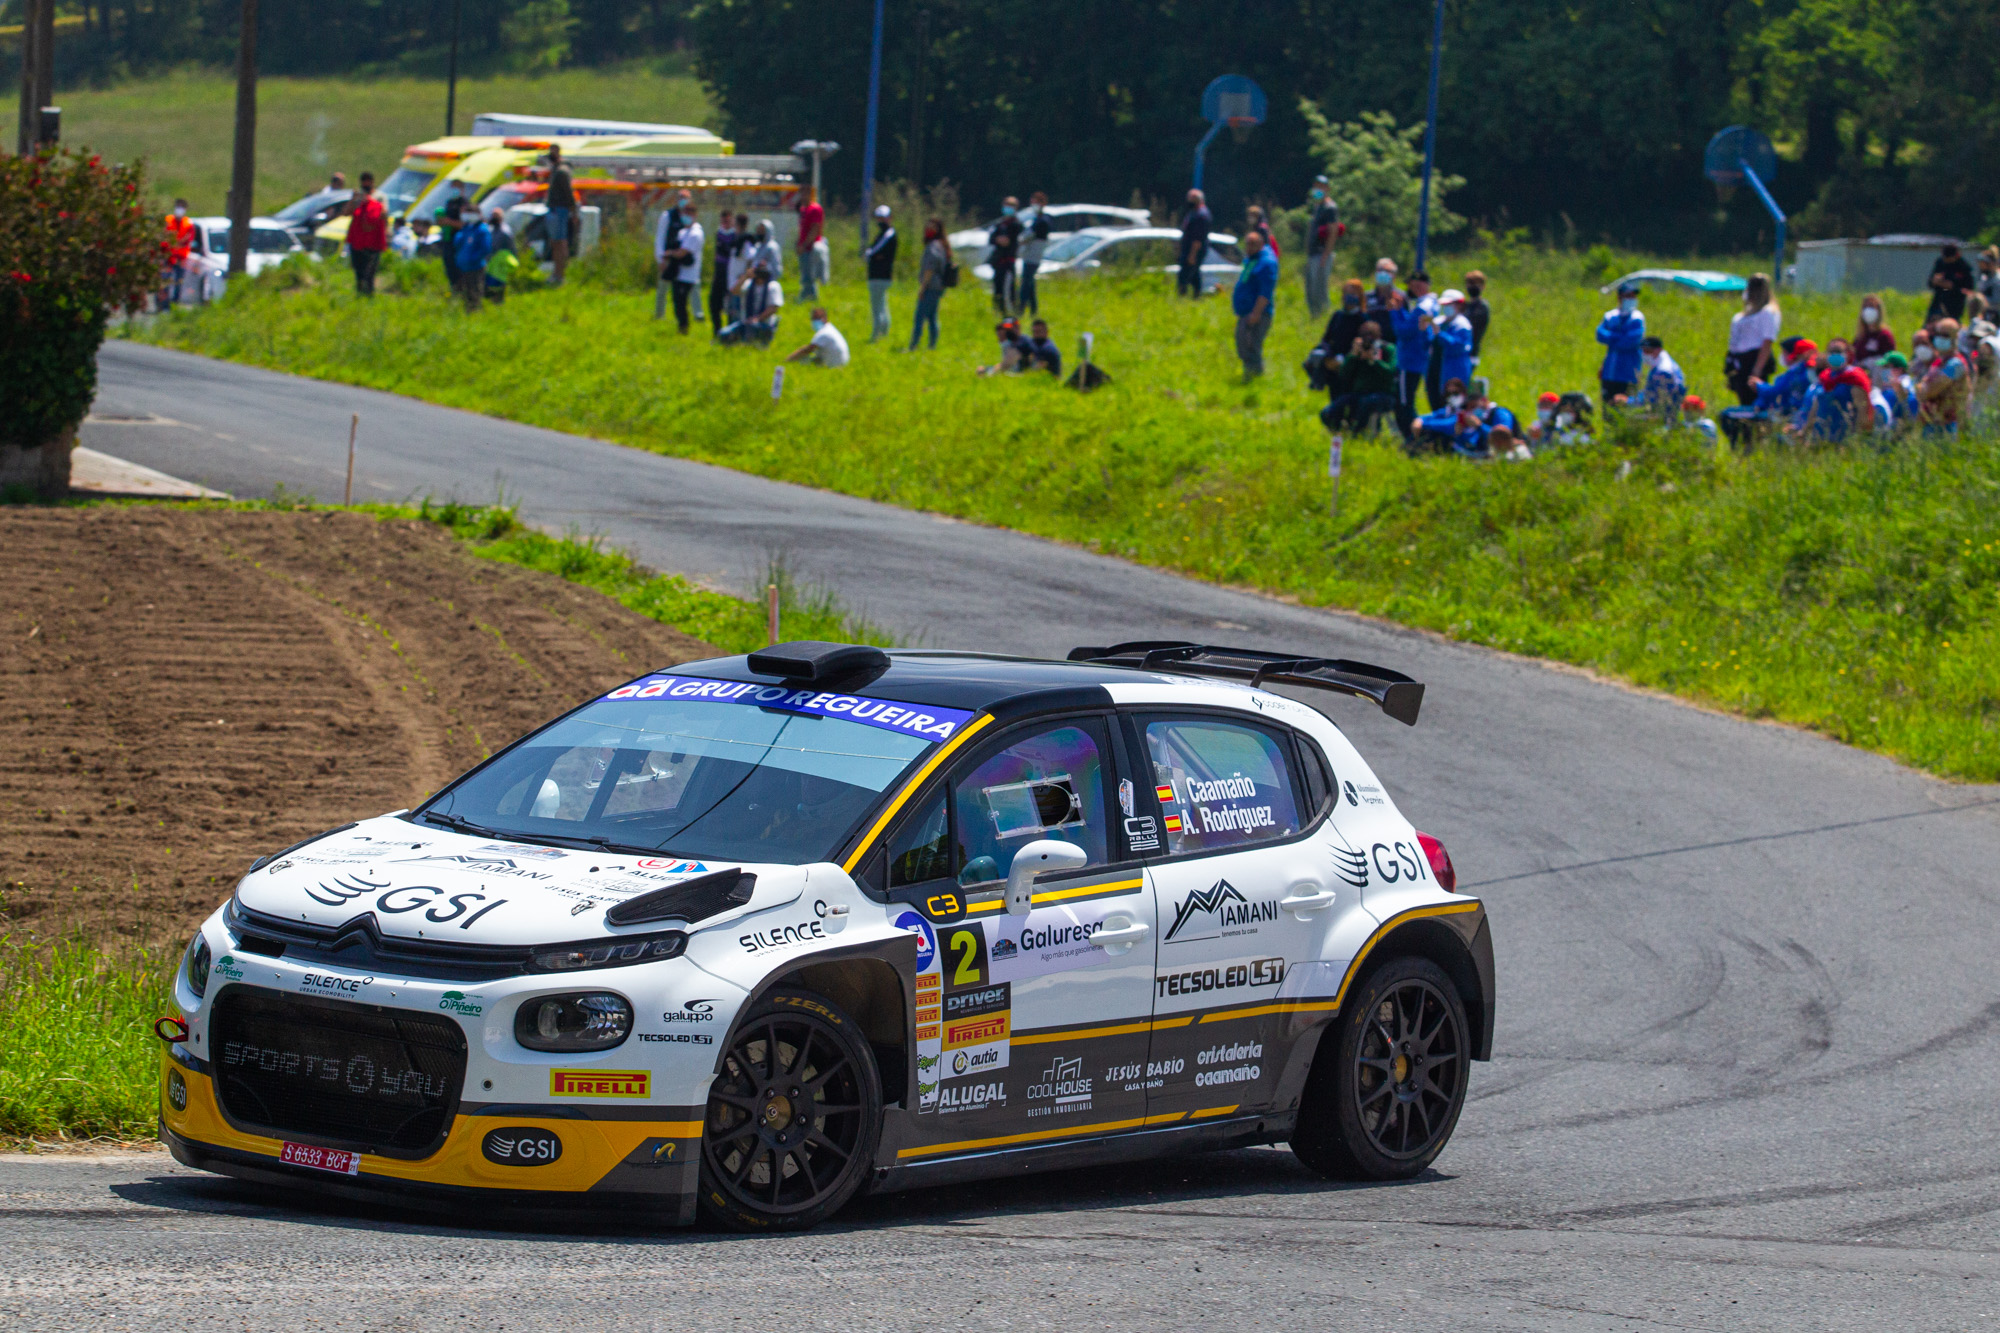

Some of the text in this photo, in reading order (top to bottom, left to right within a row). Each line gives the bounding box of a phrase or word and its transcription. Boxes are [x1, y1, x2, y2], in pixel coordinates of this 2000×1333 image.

[670, 681, 780, 702] GRUPO
[785, 687, 957, 739] REGUEIRA
[1171, 772, 1257, 804] I. Caamaño
[1124, 815, 1158, 836] C3
[1181, 809, 1200, 836] A.
[1371, 841, 1427, 884] GSI
[376, 885, 509, 930] GSI
[926, 893, 960, 916] C3
[738, 921, 826, 953] SILENCE
[1221, 929, 1241, 938] tenemos
[1247, 927, 1258, 935] casa
[950, 930, 980, 986] 2
[1041, 953, 1053, 962] Algo
[1053, 949, 1064, 959] más
[1064, 949, 1075, 958] que
[302, 973, 362, 992] SILENCE
[1157, 957, 1285, 998] TECSOLED LST
[299, 987, 356, 999] URBAN ECOMOBILITY
[663, 1010, 713, 1023] galuppo
[638, 1033, 713, 1045] TECSOLED LST
[948, 1017, 1006, 1044] PIRELLI
[225, 1040, 342, 1081] SPORTS
[971, 1048, 998, 1066] autia
[554, 1072, 648, 1094] PIRELLI
[1124, 1082, 1140, 1092] CASA
[1146, 1079, 1164, 1089] BAÑO
[1195, 1063, 1261, 1088] caamaño
[175, 1083, 186, 1106] GSI
[939, 1082, 1007, 1108] ALUGAL
[1027, 1078, 1093, 1100] COOLHOUSE
[1027, 1101, 1093, 1117] GESTIÓN INMOBILIARIA
[284, 1144, 349, 1169] S 6533 BCF
[517, 1138, 556, 1159] GSI
